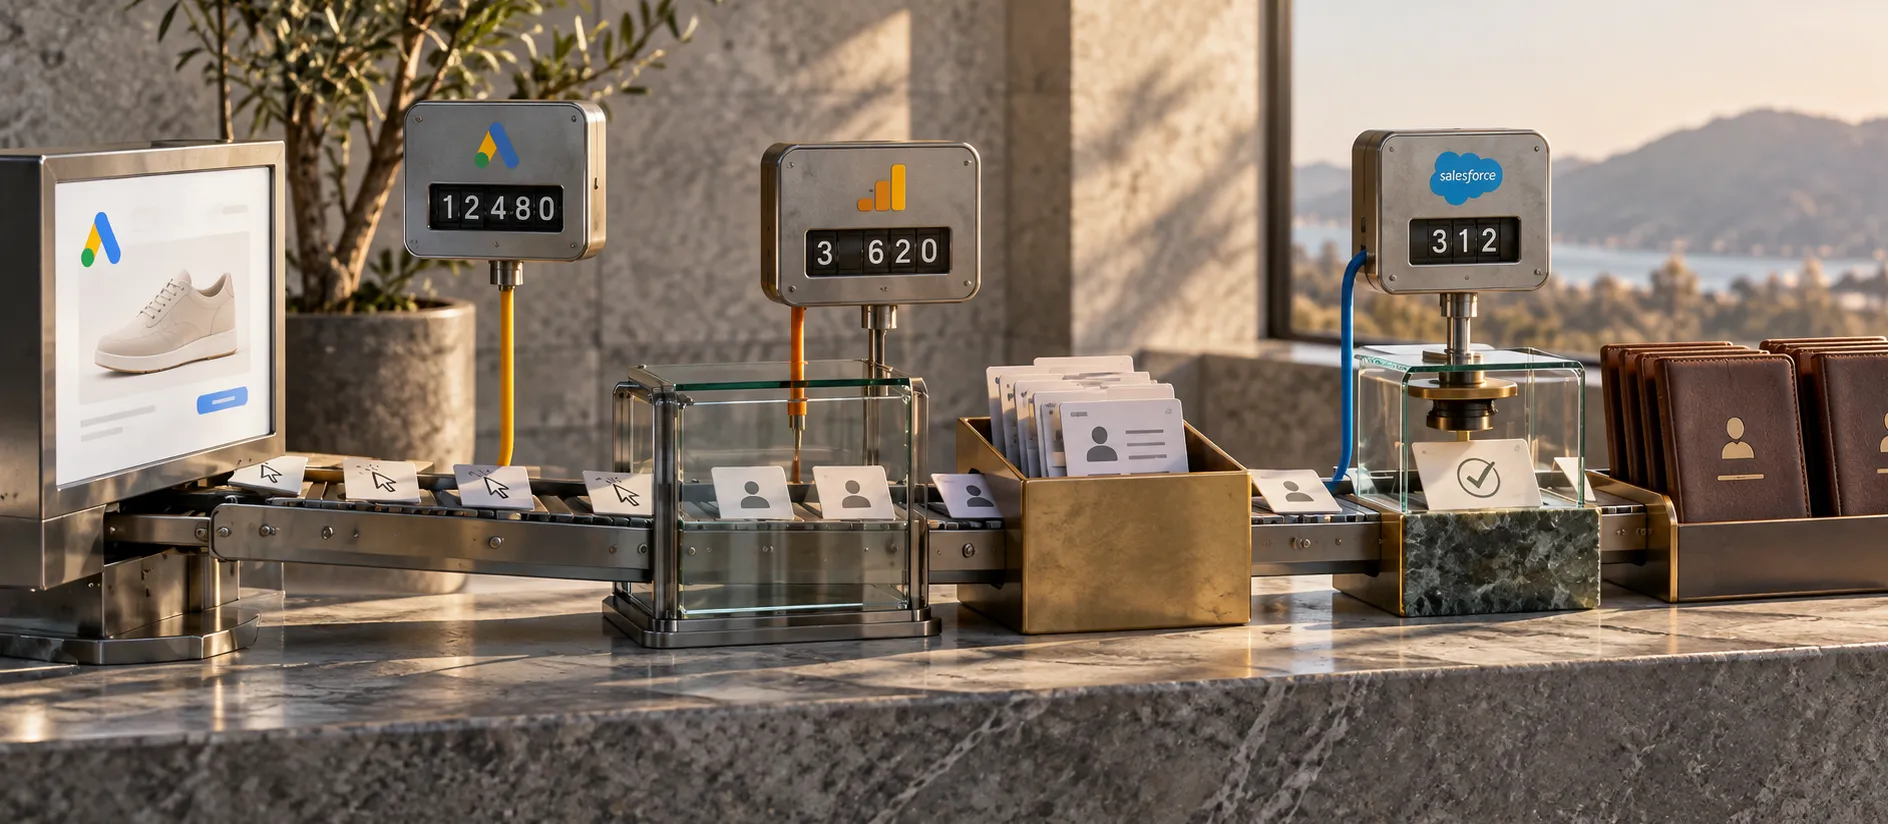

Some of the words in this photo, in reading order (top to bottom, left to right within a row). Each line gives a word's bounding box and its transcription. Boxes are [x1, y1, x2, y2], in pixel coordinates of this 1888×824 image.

[1440, 169, 1496, 184] salesforce
[443, 195, 555, 221] 12480
[1432, 228, 1497, 253] 312
